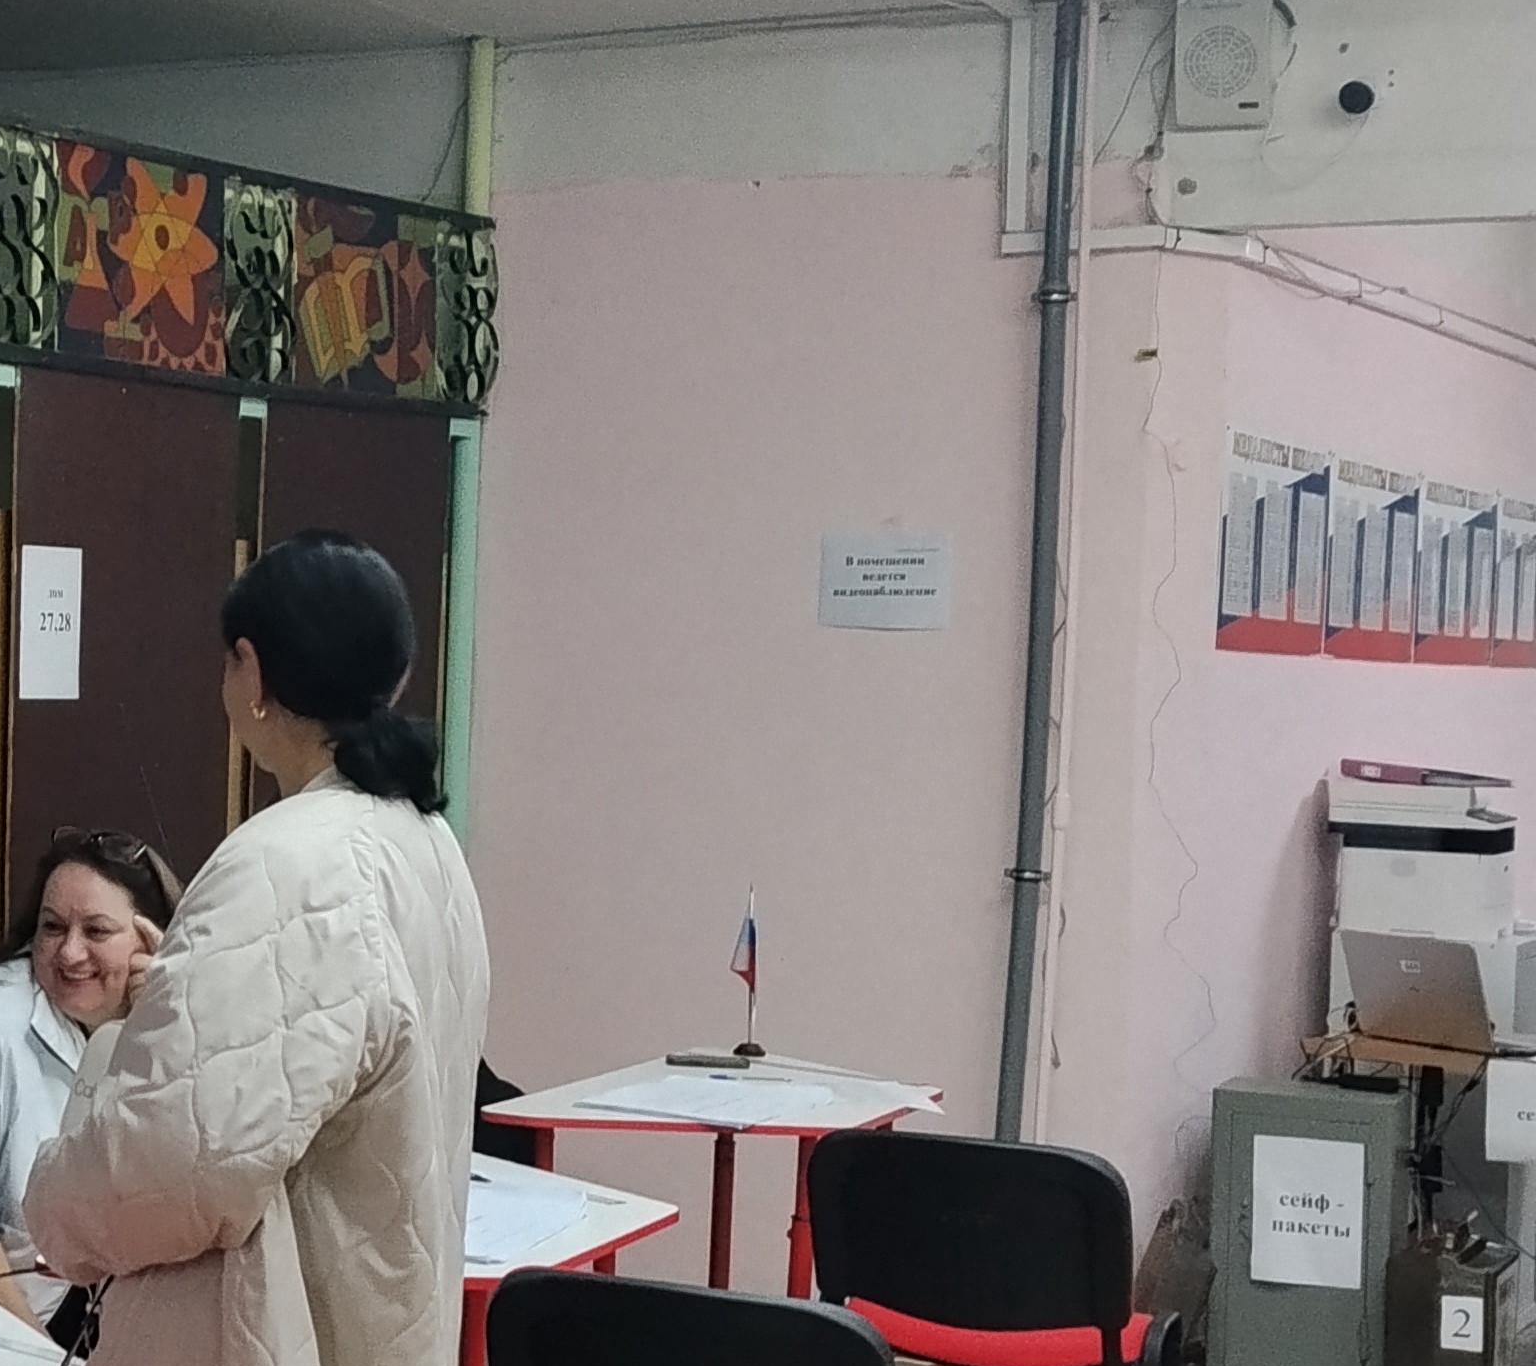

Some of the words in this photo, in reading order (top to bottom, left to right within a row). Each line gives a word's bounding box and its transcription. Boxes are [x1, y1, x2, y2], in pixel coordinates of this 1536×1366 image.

[39, 611, 72, 635] 27,28
[1279, 1192, 1331, 1214] сейф
[1271, 1219, 1351, 1239] пакеты
[1450, 1308, 1472, 1338] 2
